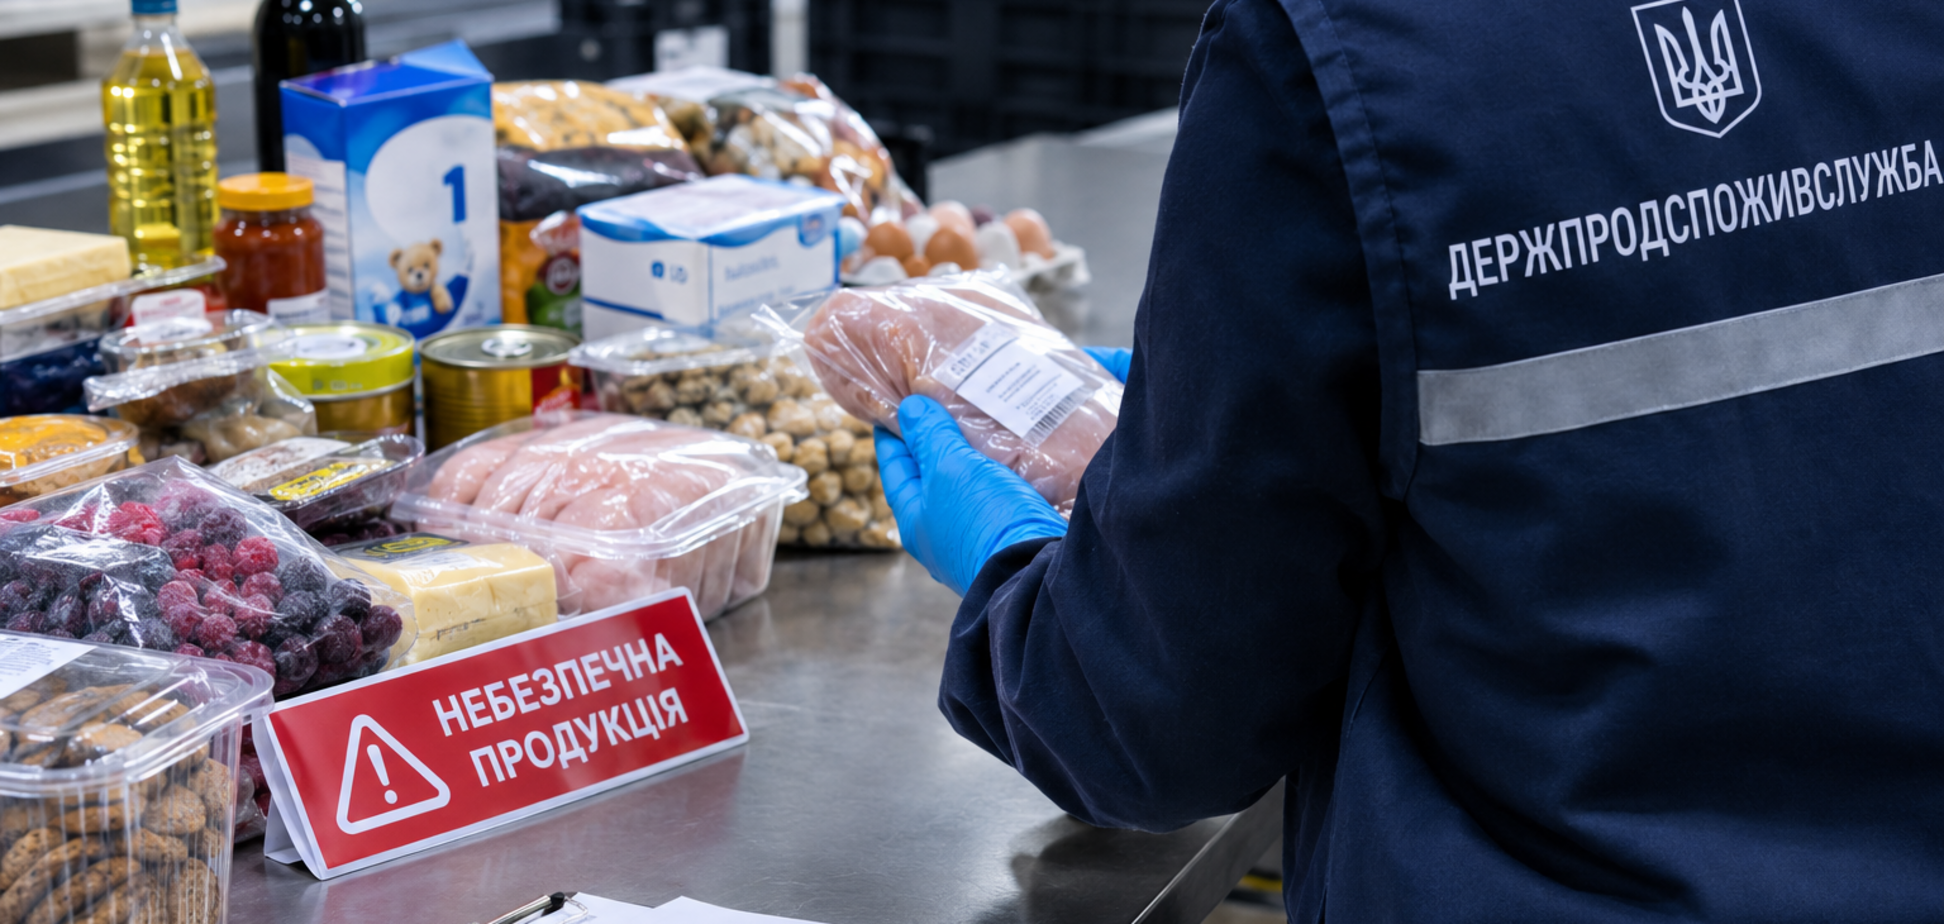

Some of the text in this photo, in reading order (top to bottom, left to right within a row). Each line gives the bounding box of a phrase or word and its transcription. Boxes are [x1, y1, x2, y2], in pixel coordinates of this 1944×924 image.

[443, 164, 466, 223] 1
[1448, 140, 1944, 300] ДЕРЖПРОДСПОЖИВСЛУЖБА
[432, 633, 683, 737] НЕБЕЗПЕЧНА
[469, 687, 688, 787] ПРОДУКЦІЯ
